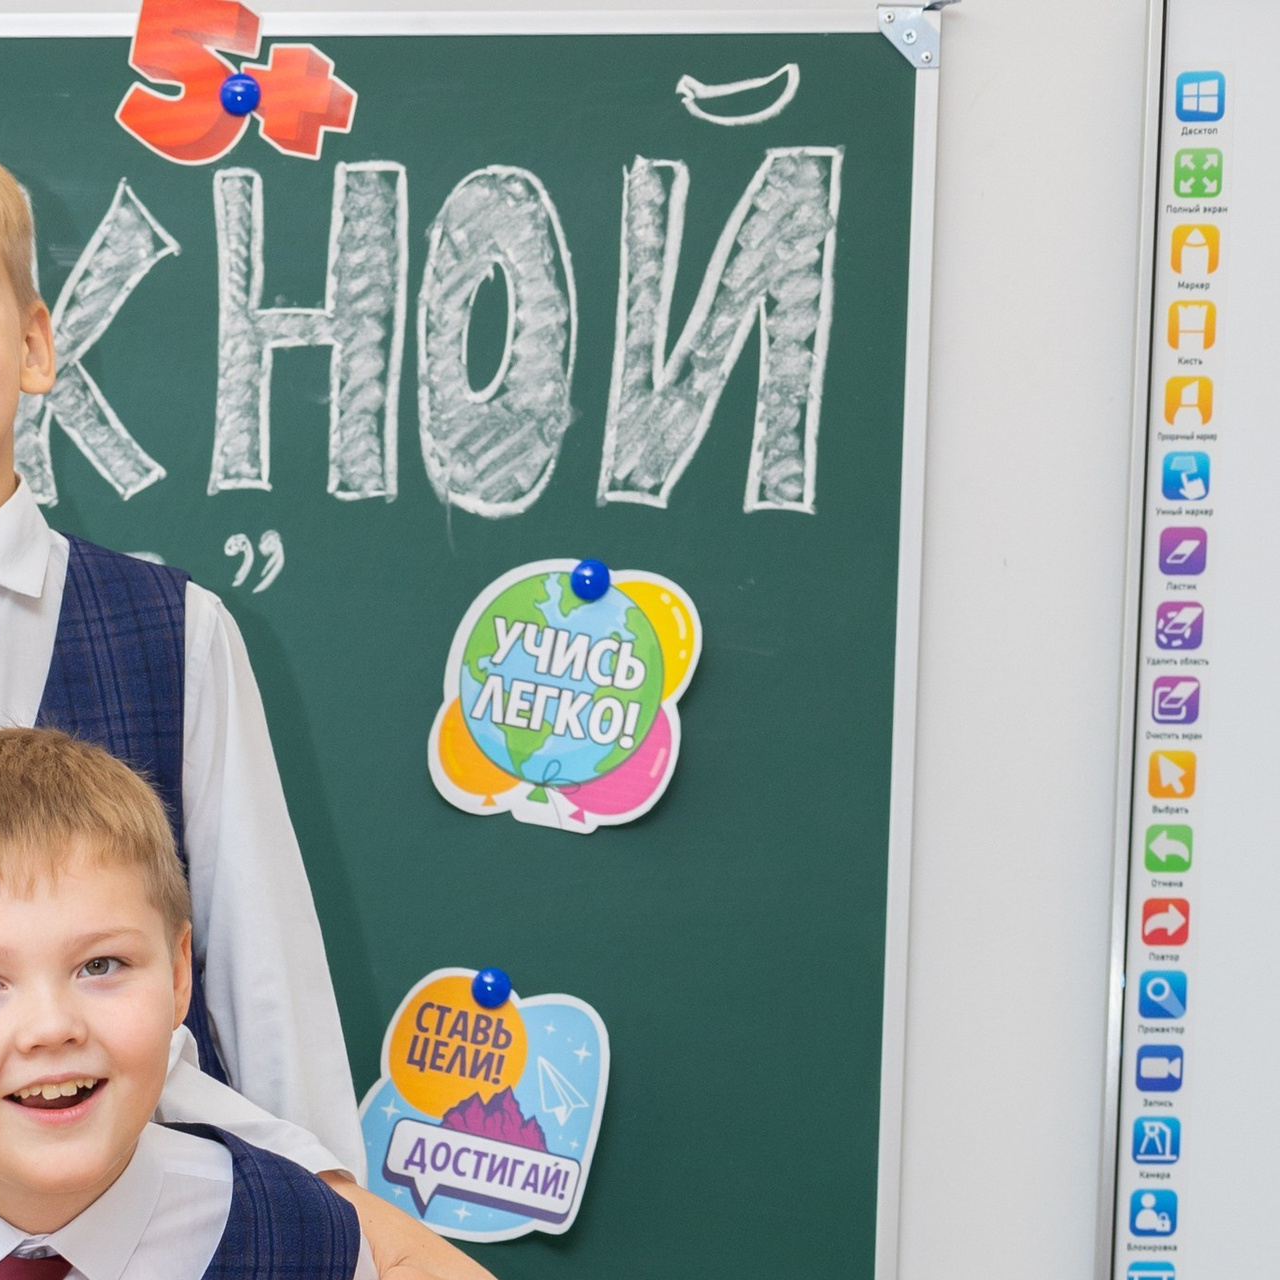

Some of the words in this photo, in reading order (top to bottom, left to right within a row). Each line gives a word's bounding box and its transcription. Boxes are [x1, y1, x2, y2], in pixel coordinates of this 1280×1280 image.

[1181, 127, 1218, 136] Десктоп
[1166, 204, 1200, 214] Полный
[1203, 206, 1228, 215] экран
[1177, 281, 1210, 291] Маркер
[1177, 357, 1203, 366] Кисть
[1166, 582, 1197, 591] Ластик
[490, 616, 647, 691] УЧИСЬ
[470, 674, 642, 750] ЛЕГКО!
[1152, 805, 1189, 815] Выбрать
[1149, 953, 1179, 963] Повтор
[415, 1001, 513, 1050] СТАВЬ
[406, 1035, 506, 1085] ЦЕЛИ!
[403, 1137, 570, 1201] ДОСТИГАЙ!
